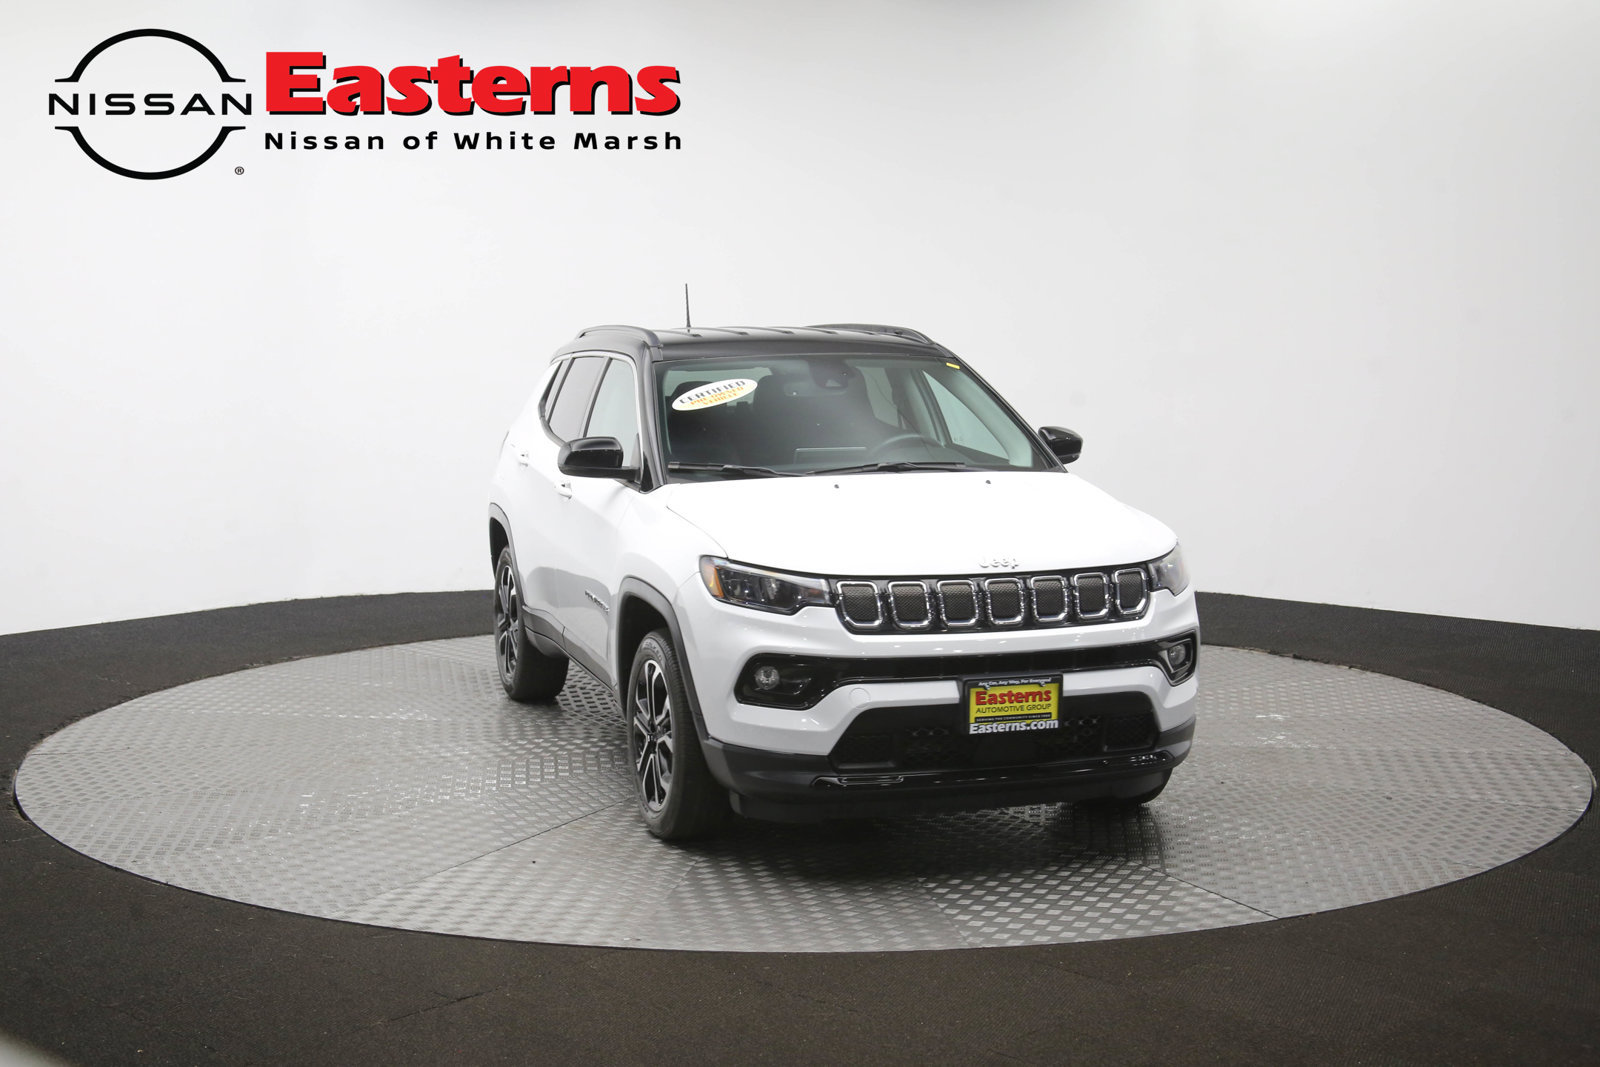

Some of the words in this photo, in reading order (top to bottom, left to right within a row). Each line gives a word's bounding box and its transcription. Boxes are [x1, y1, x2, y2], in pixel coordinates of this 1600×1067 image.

[679, 380, 746, 404] CERTIFIED
[978, 553, 1020, 570] Jeep
[975, 690, 1052, 706] Easterns
[976, 705, 1025, 714] AUTOMOTIVE
[969, 720, 1058, 734] Easterns.com
